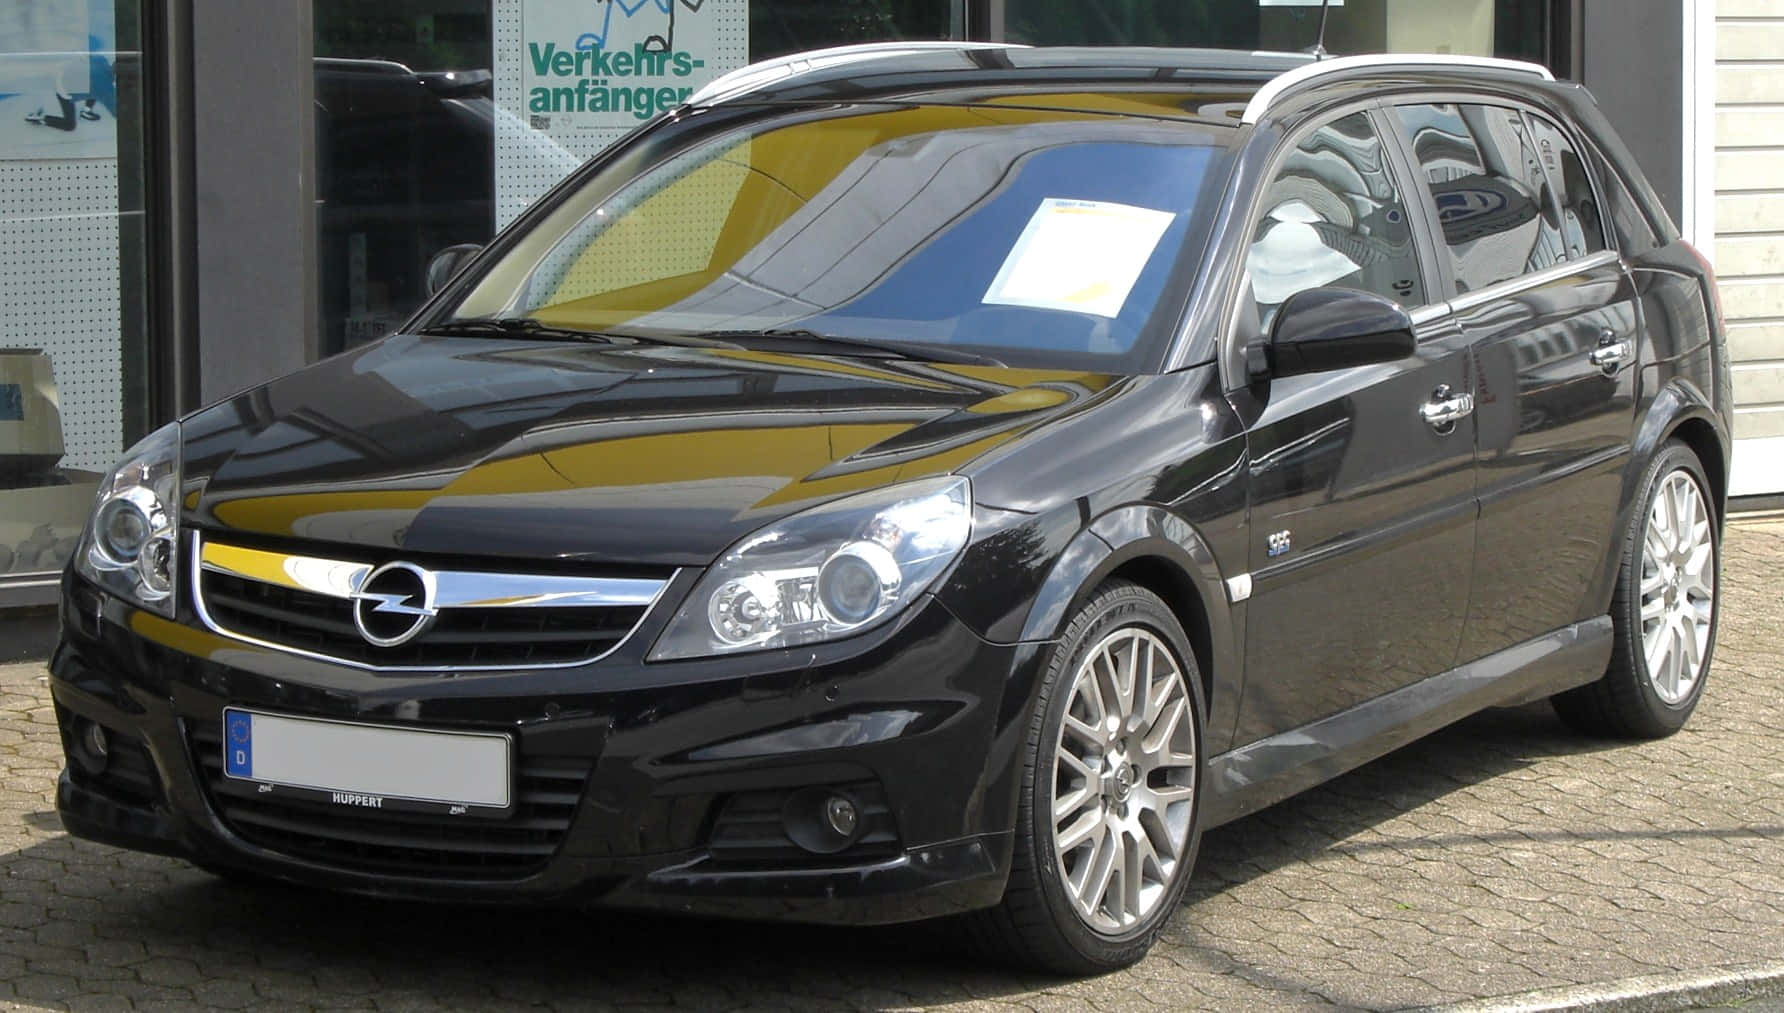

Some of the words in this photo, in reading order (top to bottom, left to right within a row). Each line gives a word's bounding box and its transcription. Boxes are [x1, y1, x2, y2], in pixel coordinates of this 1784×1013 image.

[528, 42, 705, 77] Verkehrs-
[529, 79, 693, 120] anfänger
[236, 750, 246, 766] D
[332, 792, 383, 809] HUPPERT
